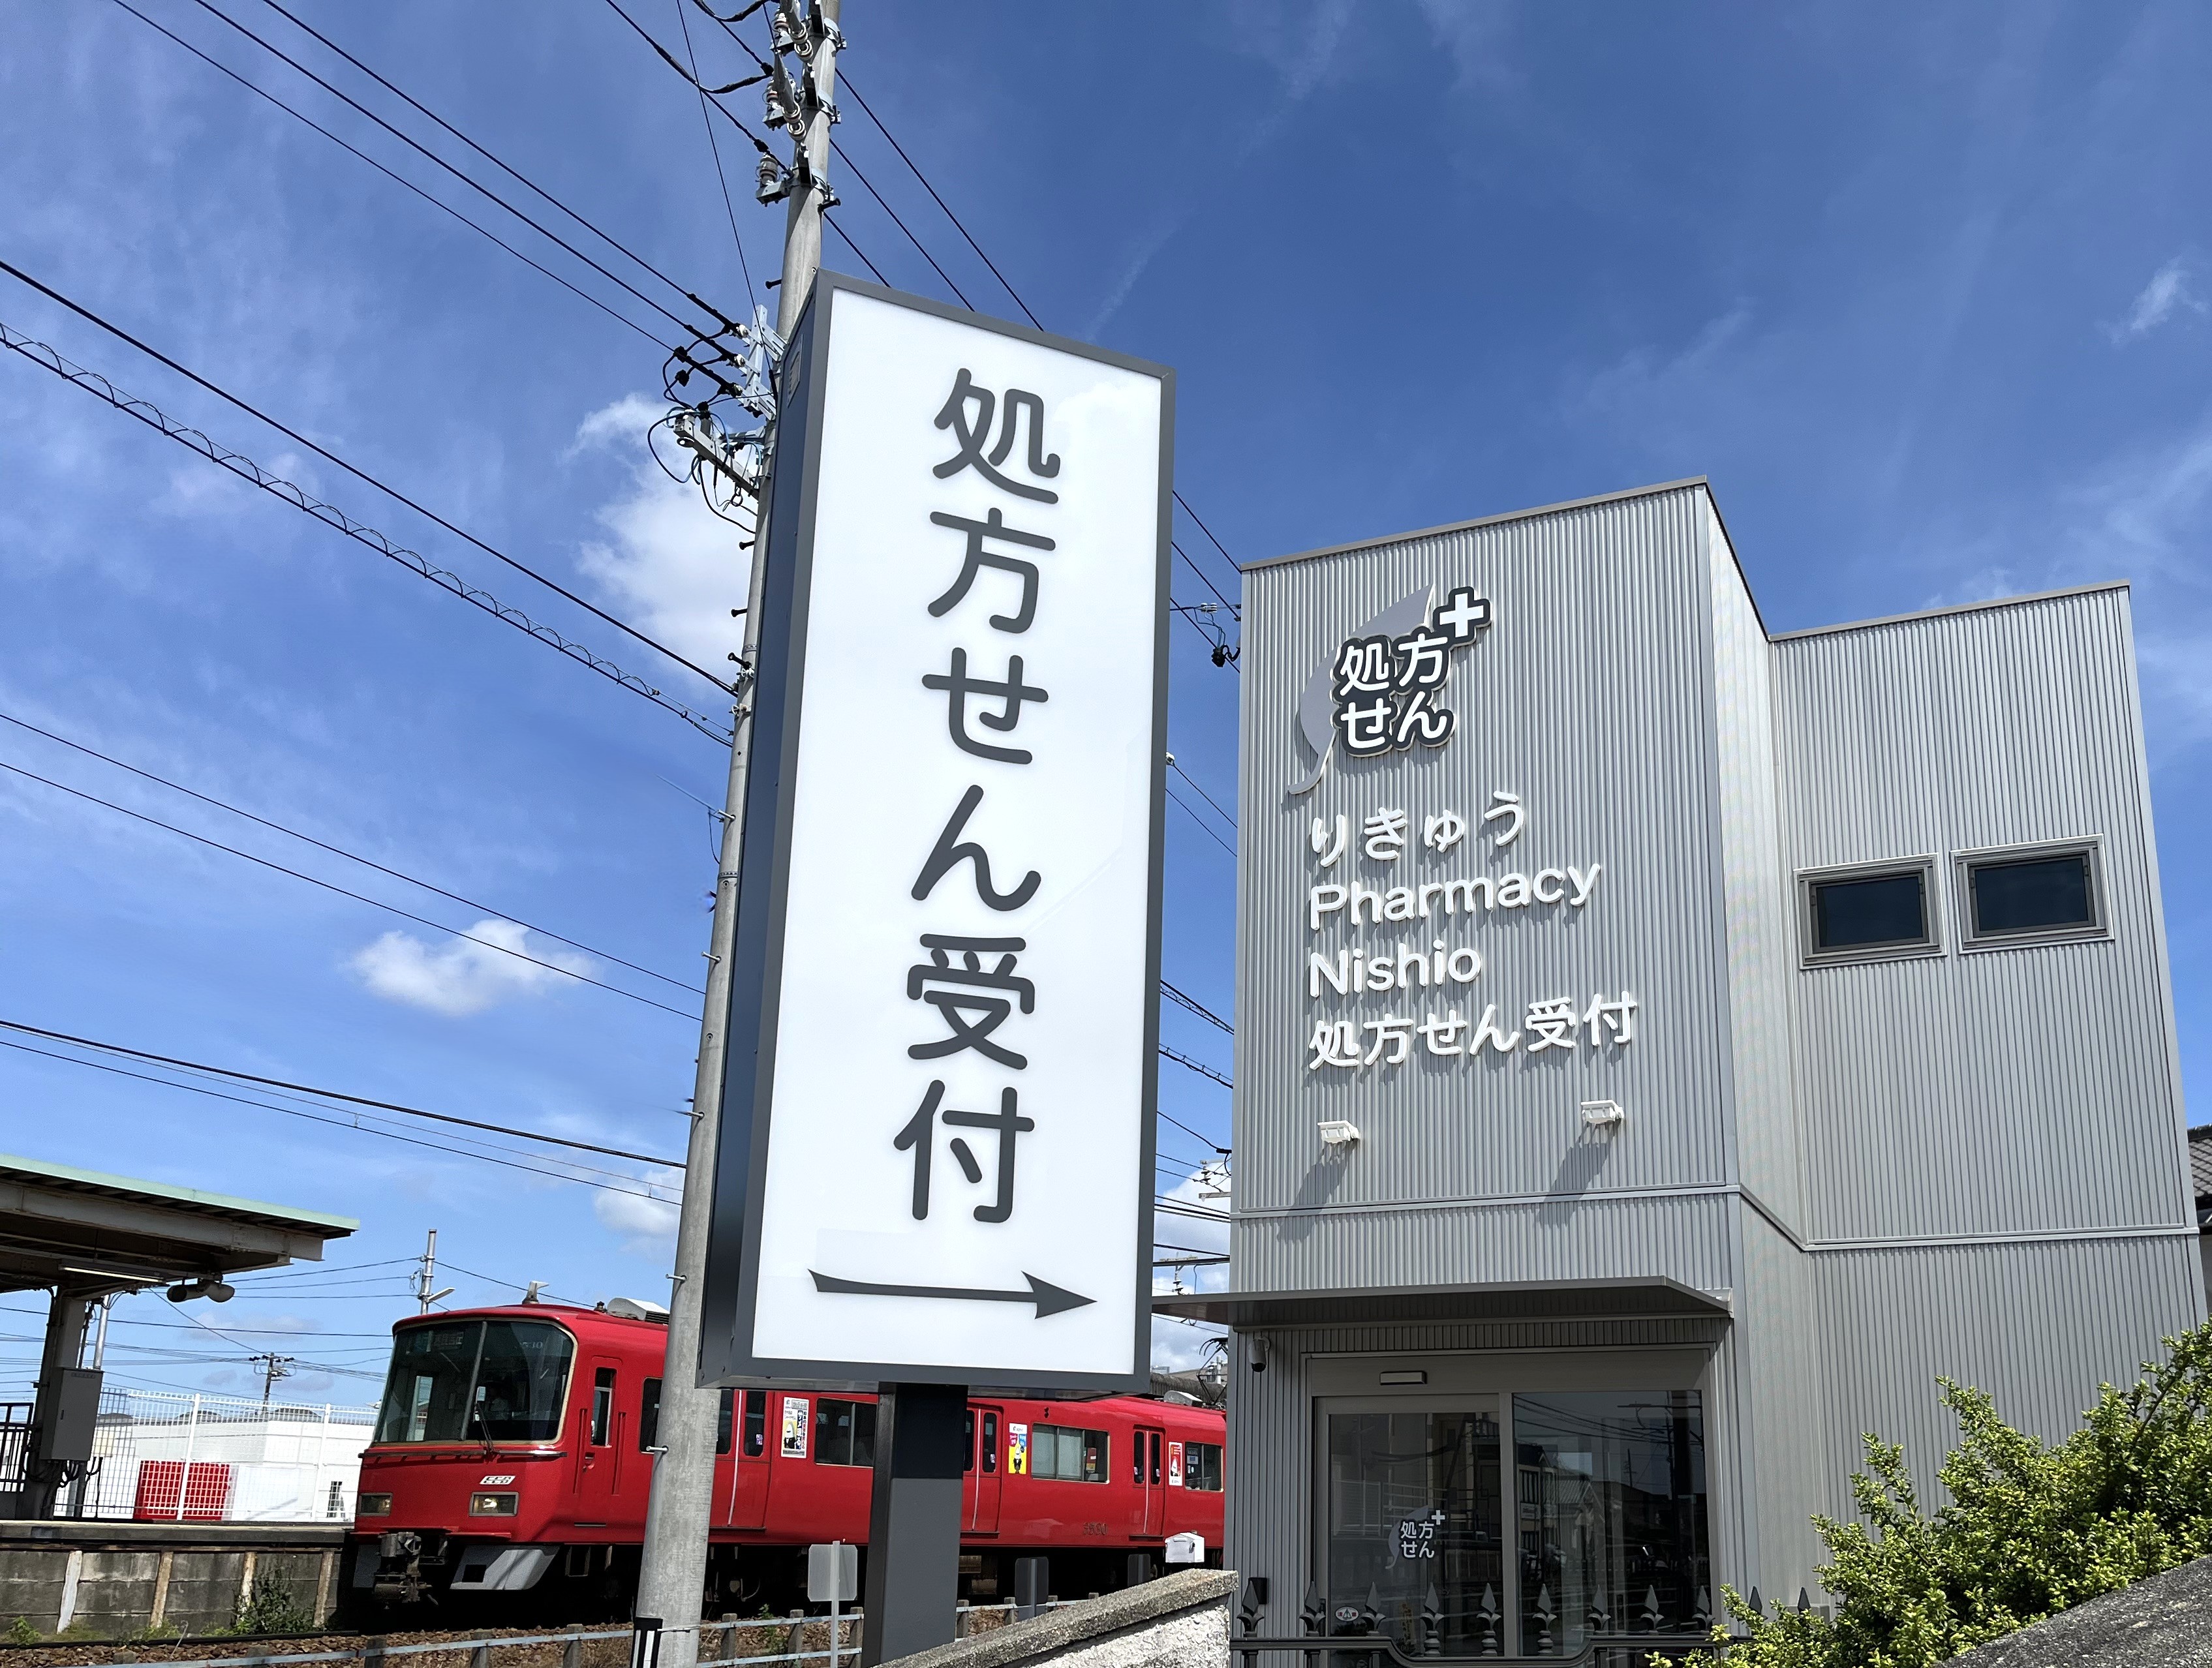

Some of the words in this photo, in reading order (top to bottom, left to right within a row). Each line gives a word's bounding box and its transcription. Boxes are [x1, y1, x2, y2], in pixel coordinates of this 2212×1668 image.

[1339, 632, 1449, 696] 処方
[1340, 691, 1448, 750] せん
[894, 367, 1061, 1224] 処方せん受付
[1311, 790, 1526, 868] りきゅう
[1310, 862, 1601, 931] Pharmacy
[1310, 939, 1482, 998] Nishio
[1308, 990, 1638, 1070] 処方せん受付
[1400, 1521, 1434, 1539] 処方
[1401, 1541, 1435, 1558] せん
